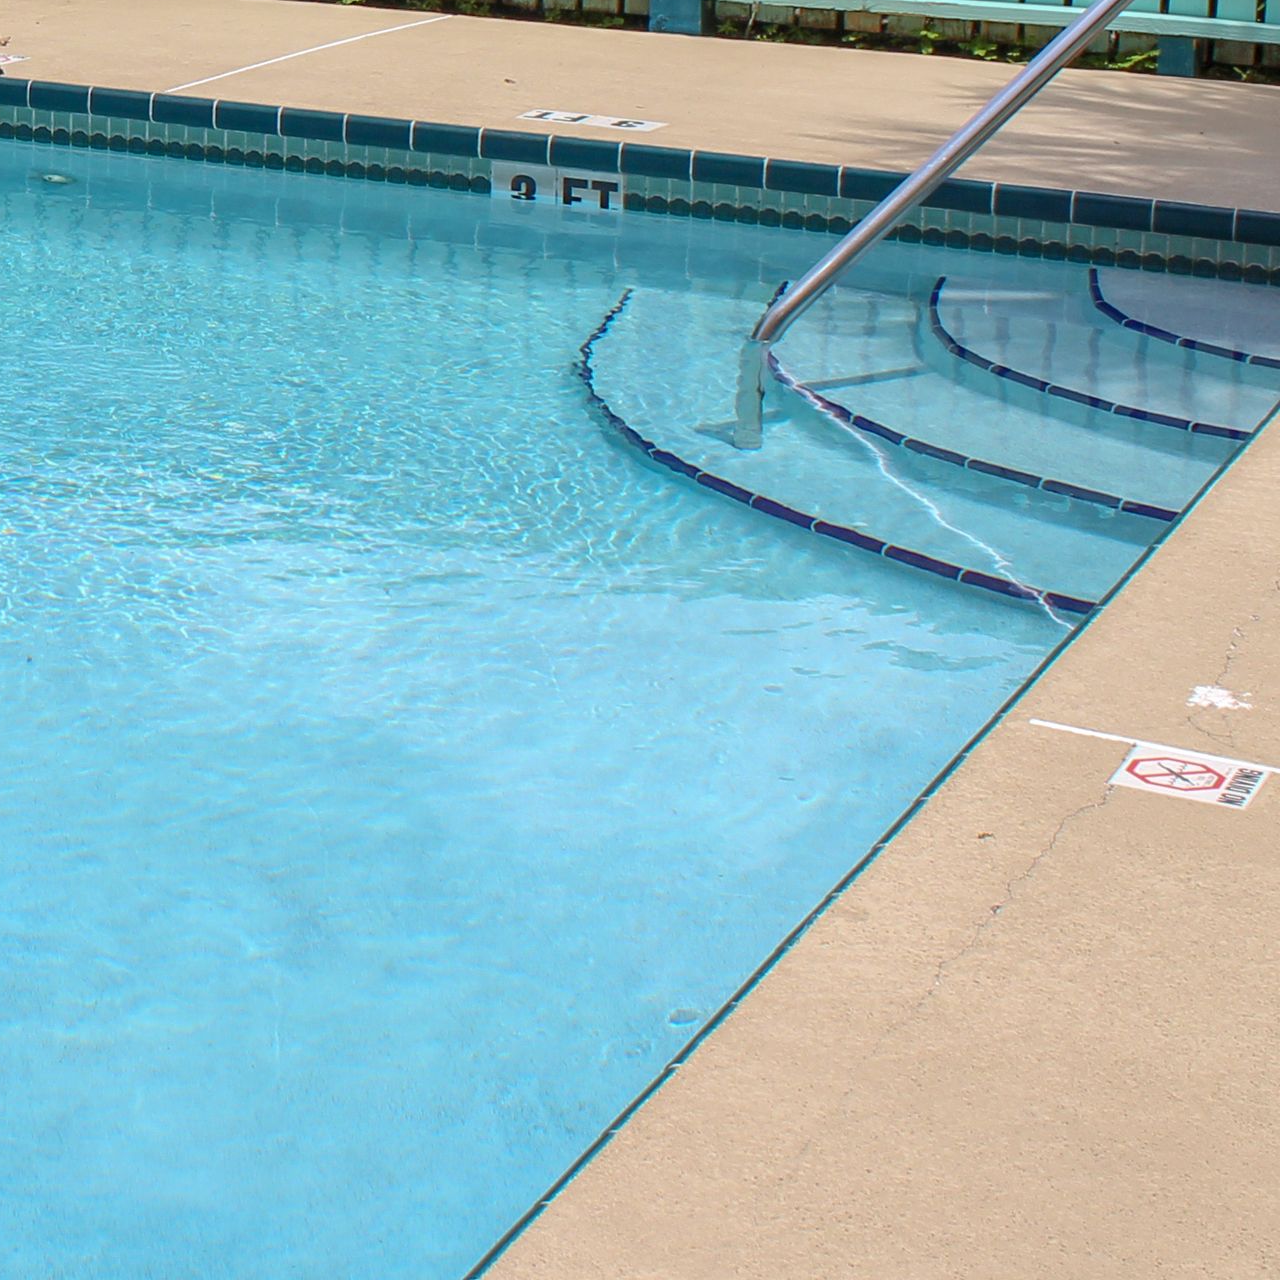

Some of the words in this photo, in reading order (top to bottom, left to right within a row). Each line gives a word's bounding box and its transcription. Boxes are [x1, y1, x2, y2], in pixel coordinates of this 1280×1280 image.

[523, 110, 590, 123] FT
[562, 177, 619, 209] FT
[1225, 768, 1264, 795] DIVING
[1216, 792, 1246, 807] NO
